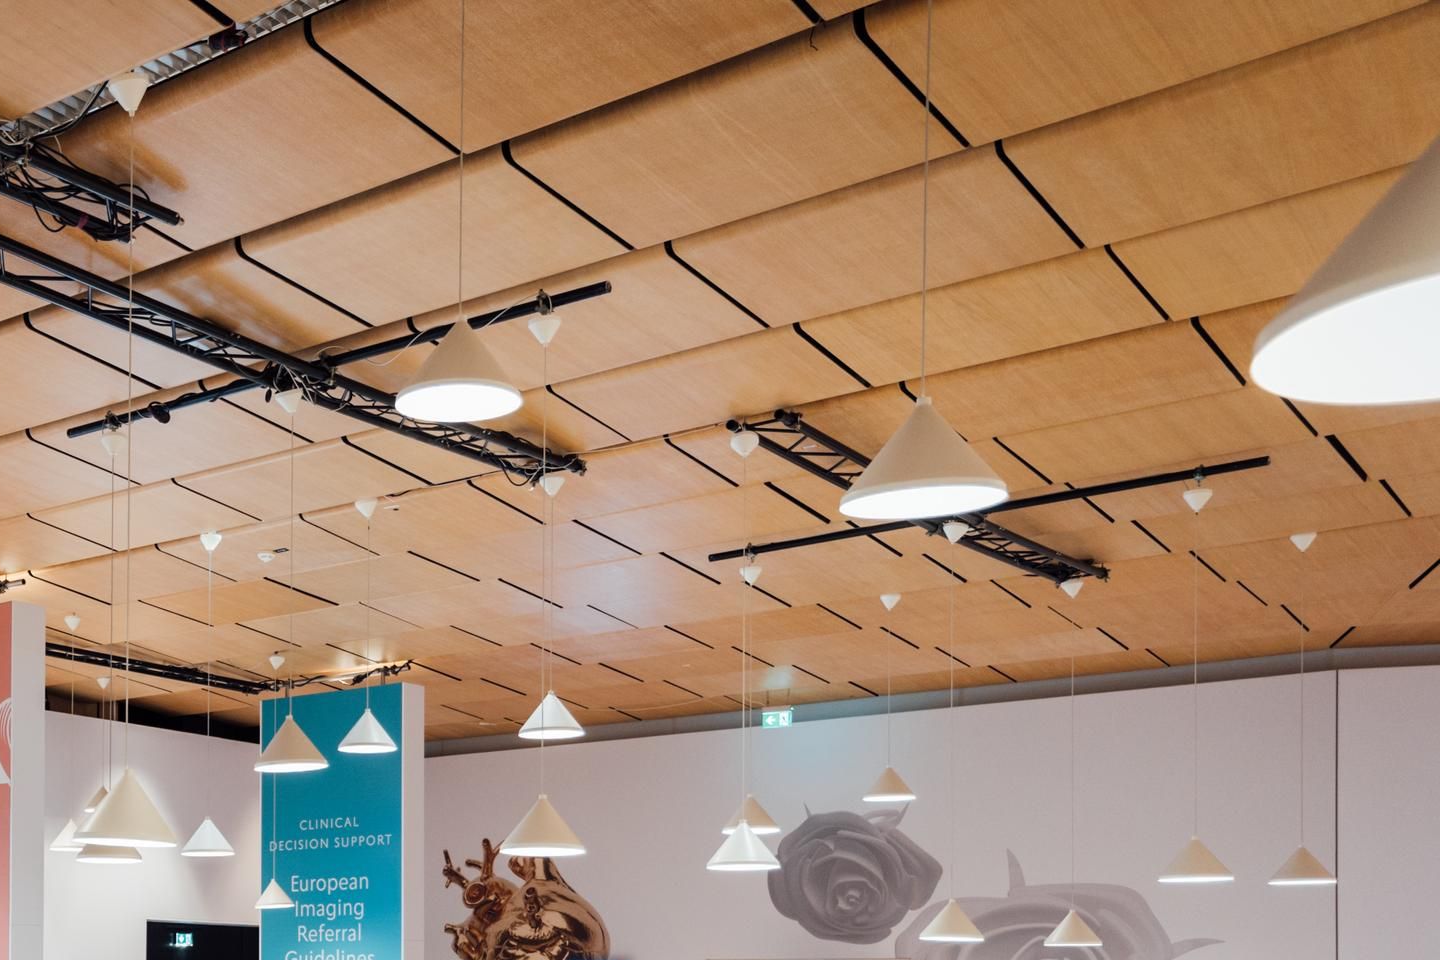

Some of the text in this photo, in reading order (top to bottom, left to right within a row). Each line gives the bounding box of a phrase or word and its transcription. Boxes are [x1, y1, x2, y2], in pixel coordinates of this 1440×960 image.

[299, 816, 359, 831] CLINICAL
[269, 834, 393, 852] DECISION SUPPORT
[291, 875, 369, 895] European
[295, 899, 365, 921] Imaging
[297, 923, 362, 942] Referral
